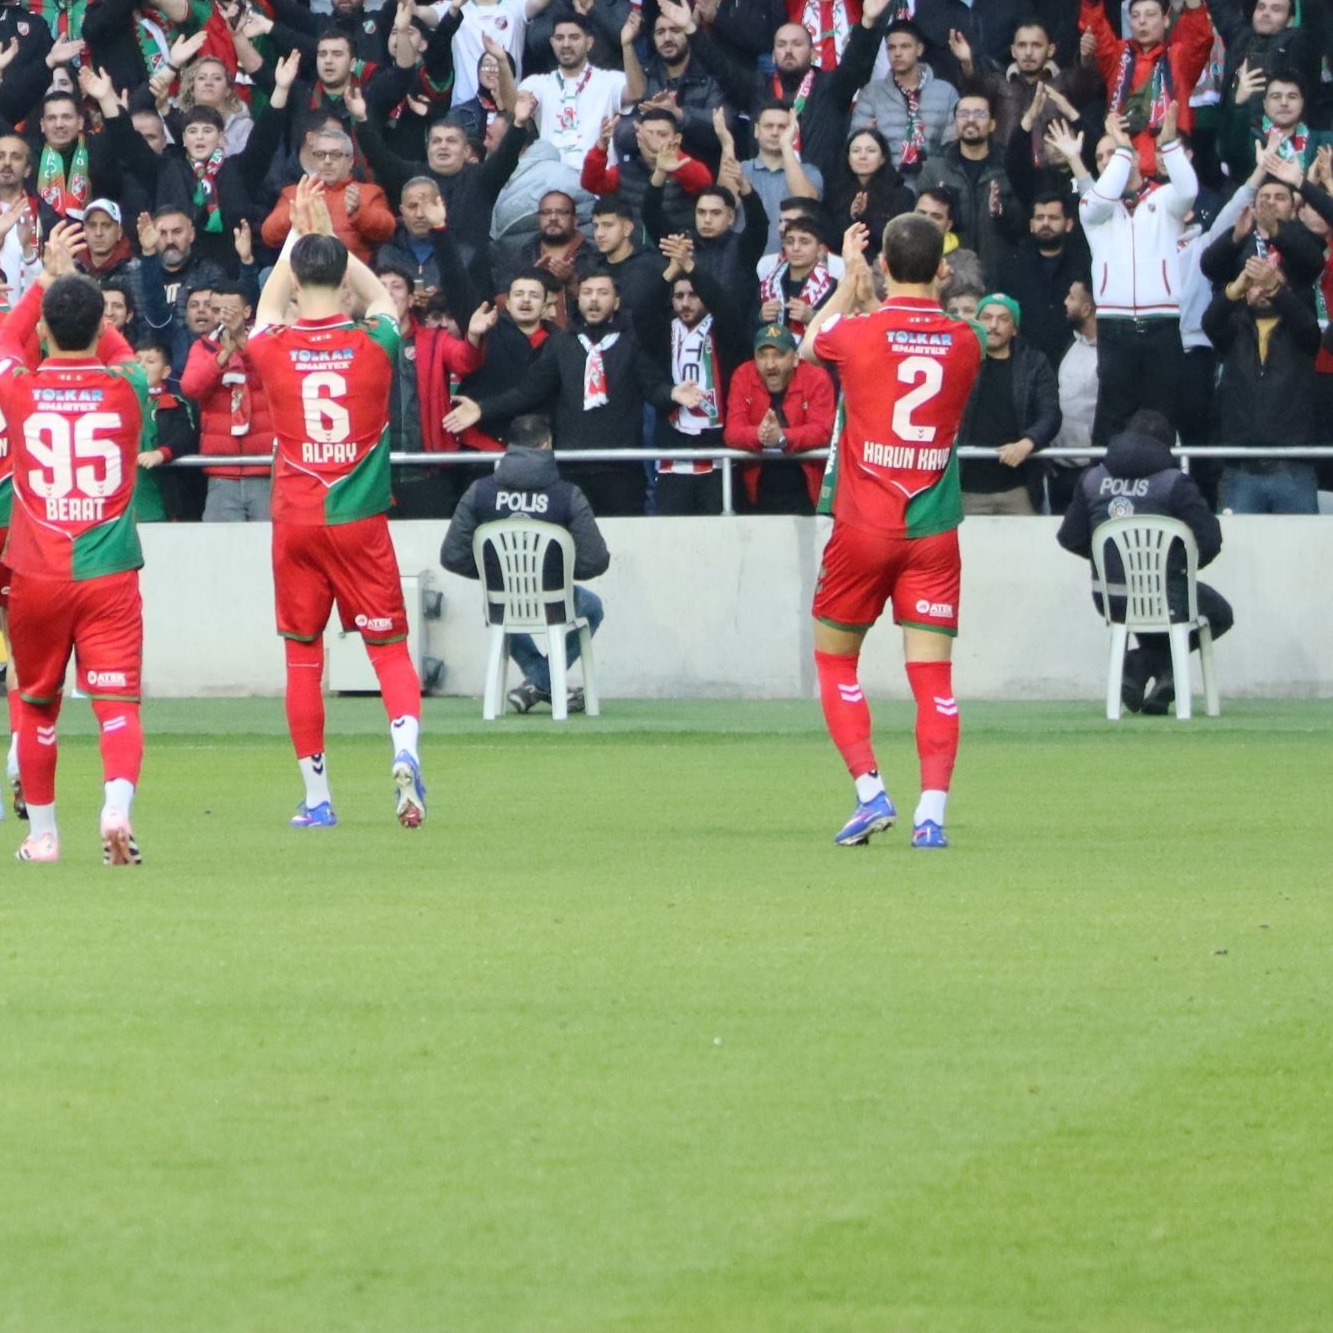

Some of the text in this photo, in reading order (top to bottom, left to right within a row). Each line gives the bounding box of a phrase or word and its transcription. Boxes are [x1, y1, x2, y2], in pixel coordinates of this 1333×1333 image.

[886, 331, 953, 346] TOLKAR
[289, 348, 354, 363] TOLKAR
[32, 388, 103, 402] TOLKAR
[891, 355, 944, 442] 2
[301, 371, 350, 443] 6
[22, 412, 123, 499] 95
[302, 443, 357, 463] ALPAY
[863, 441, 914, 469] HARUN
[1099, 477, 1149, 497] POLIS
[45, 498, 106, 521] BERAT
[495, 491, 549, 513] POLIS
[97, 672, 127, 684] ATEK
